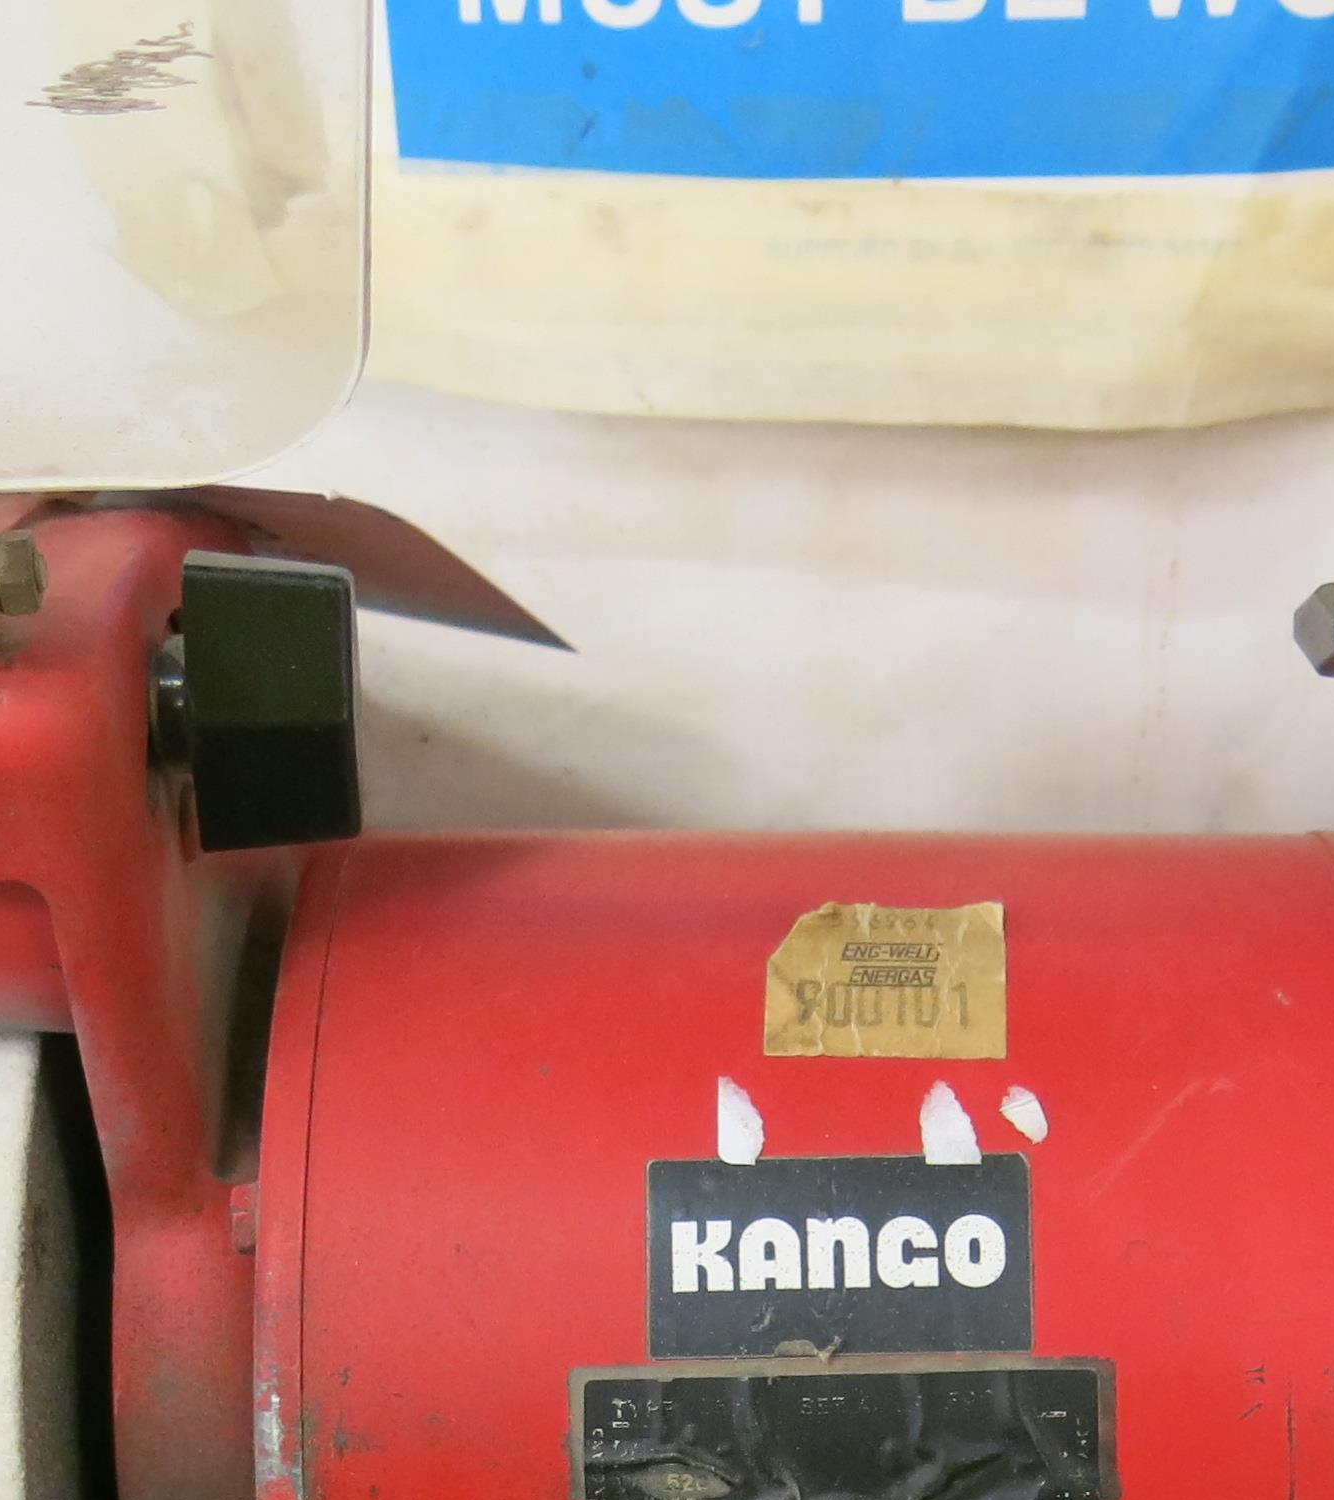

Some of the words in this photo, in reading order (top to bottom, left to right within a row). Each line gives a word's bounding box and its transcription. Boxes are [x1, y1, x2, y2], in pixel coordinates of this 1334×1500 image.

[842, 943, 941, 962] ENG-WELD
[849, 966, 938, 987] ENERGAS
[671, 1214, 1007, 1295] KANGO
